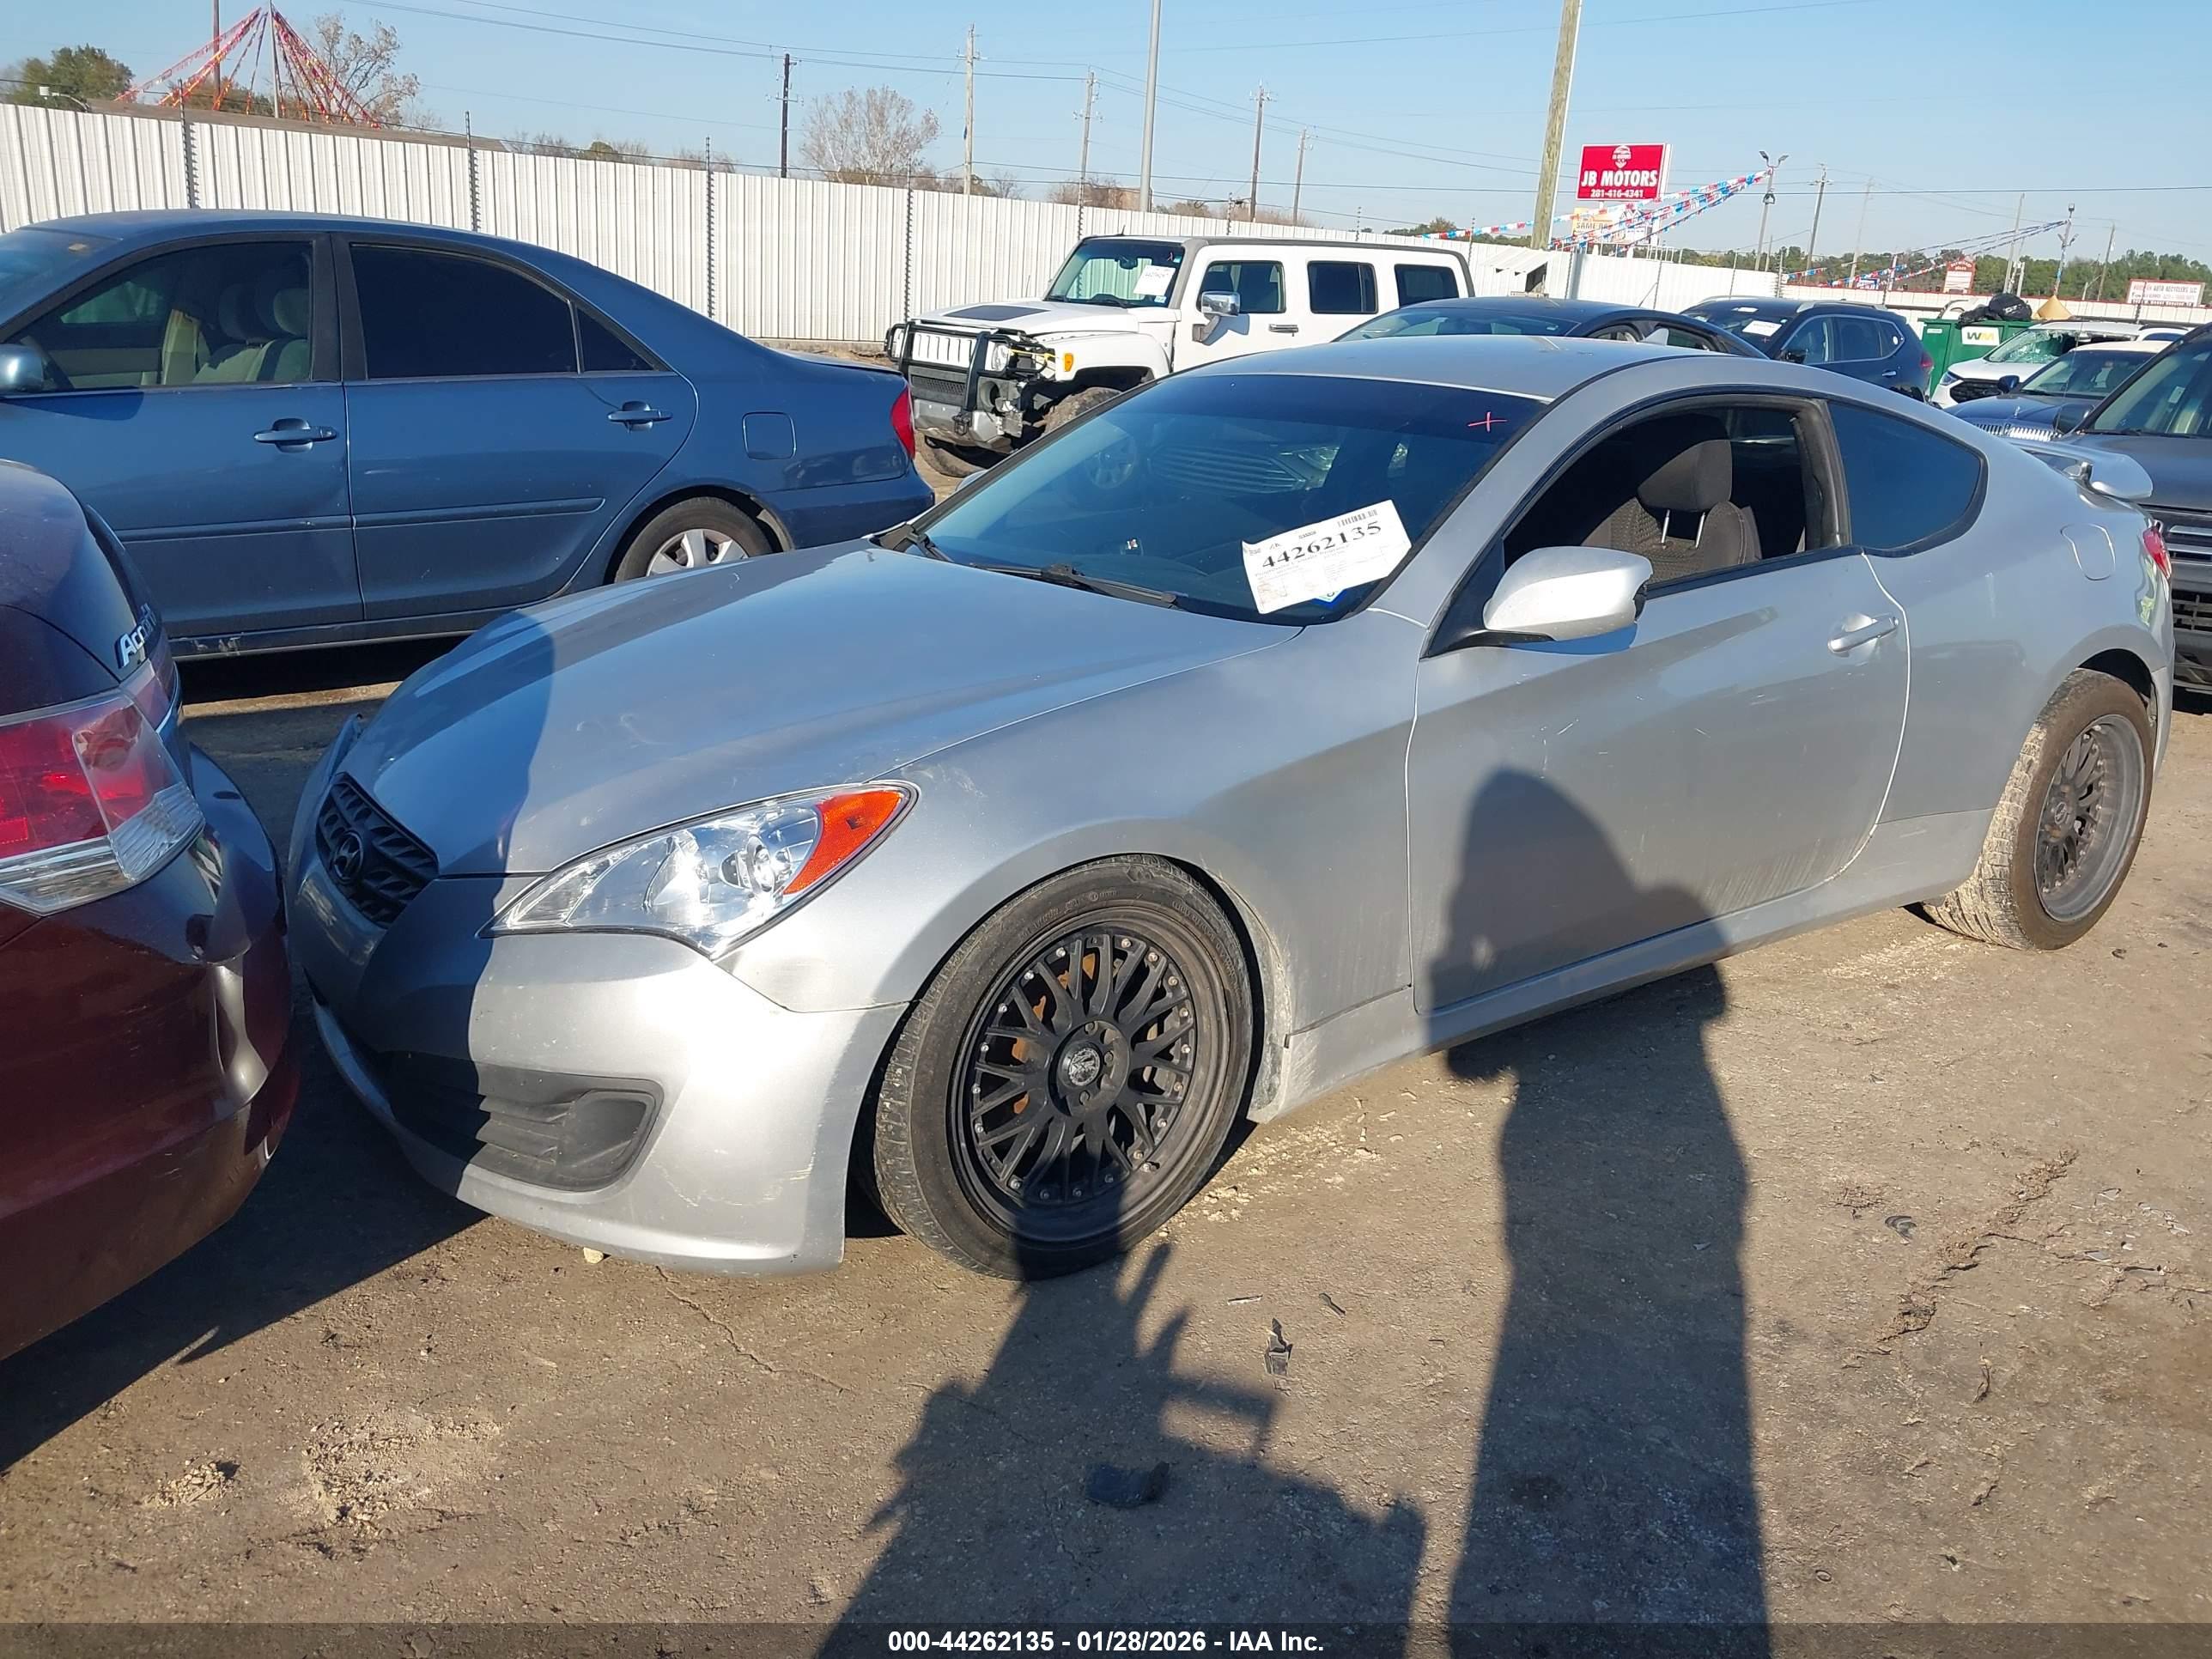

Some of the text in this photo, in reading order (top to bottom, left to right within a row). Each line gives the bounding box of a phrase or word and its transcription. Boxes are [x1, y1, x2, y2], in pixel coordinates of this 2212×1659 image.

[1581, 170, 1658, 186] JB MOTORS
[1590, 189, 1644, 198] 281-416-4341
[1966, 331, 1994, 341] WM
[1262, 520, 1382, 568] 44262135
